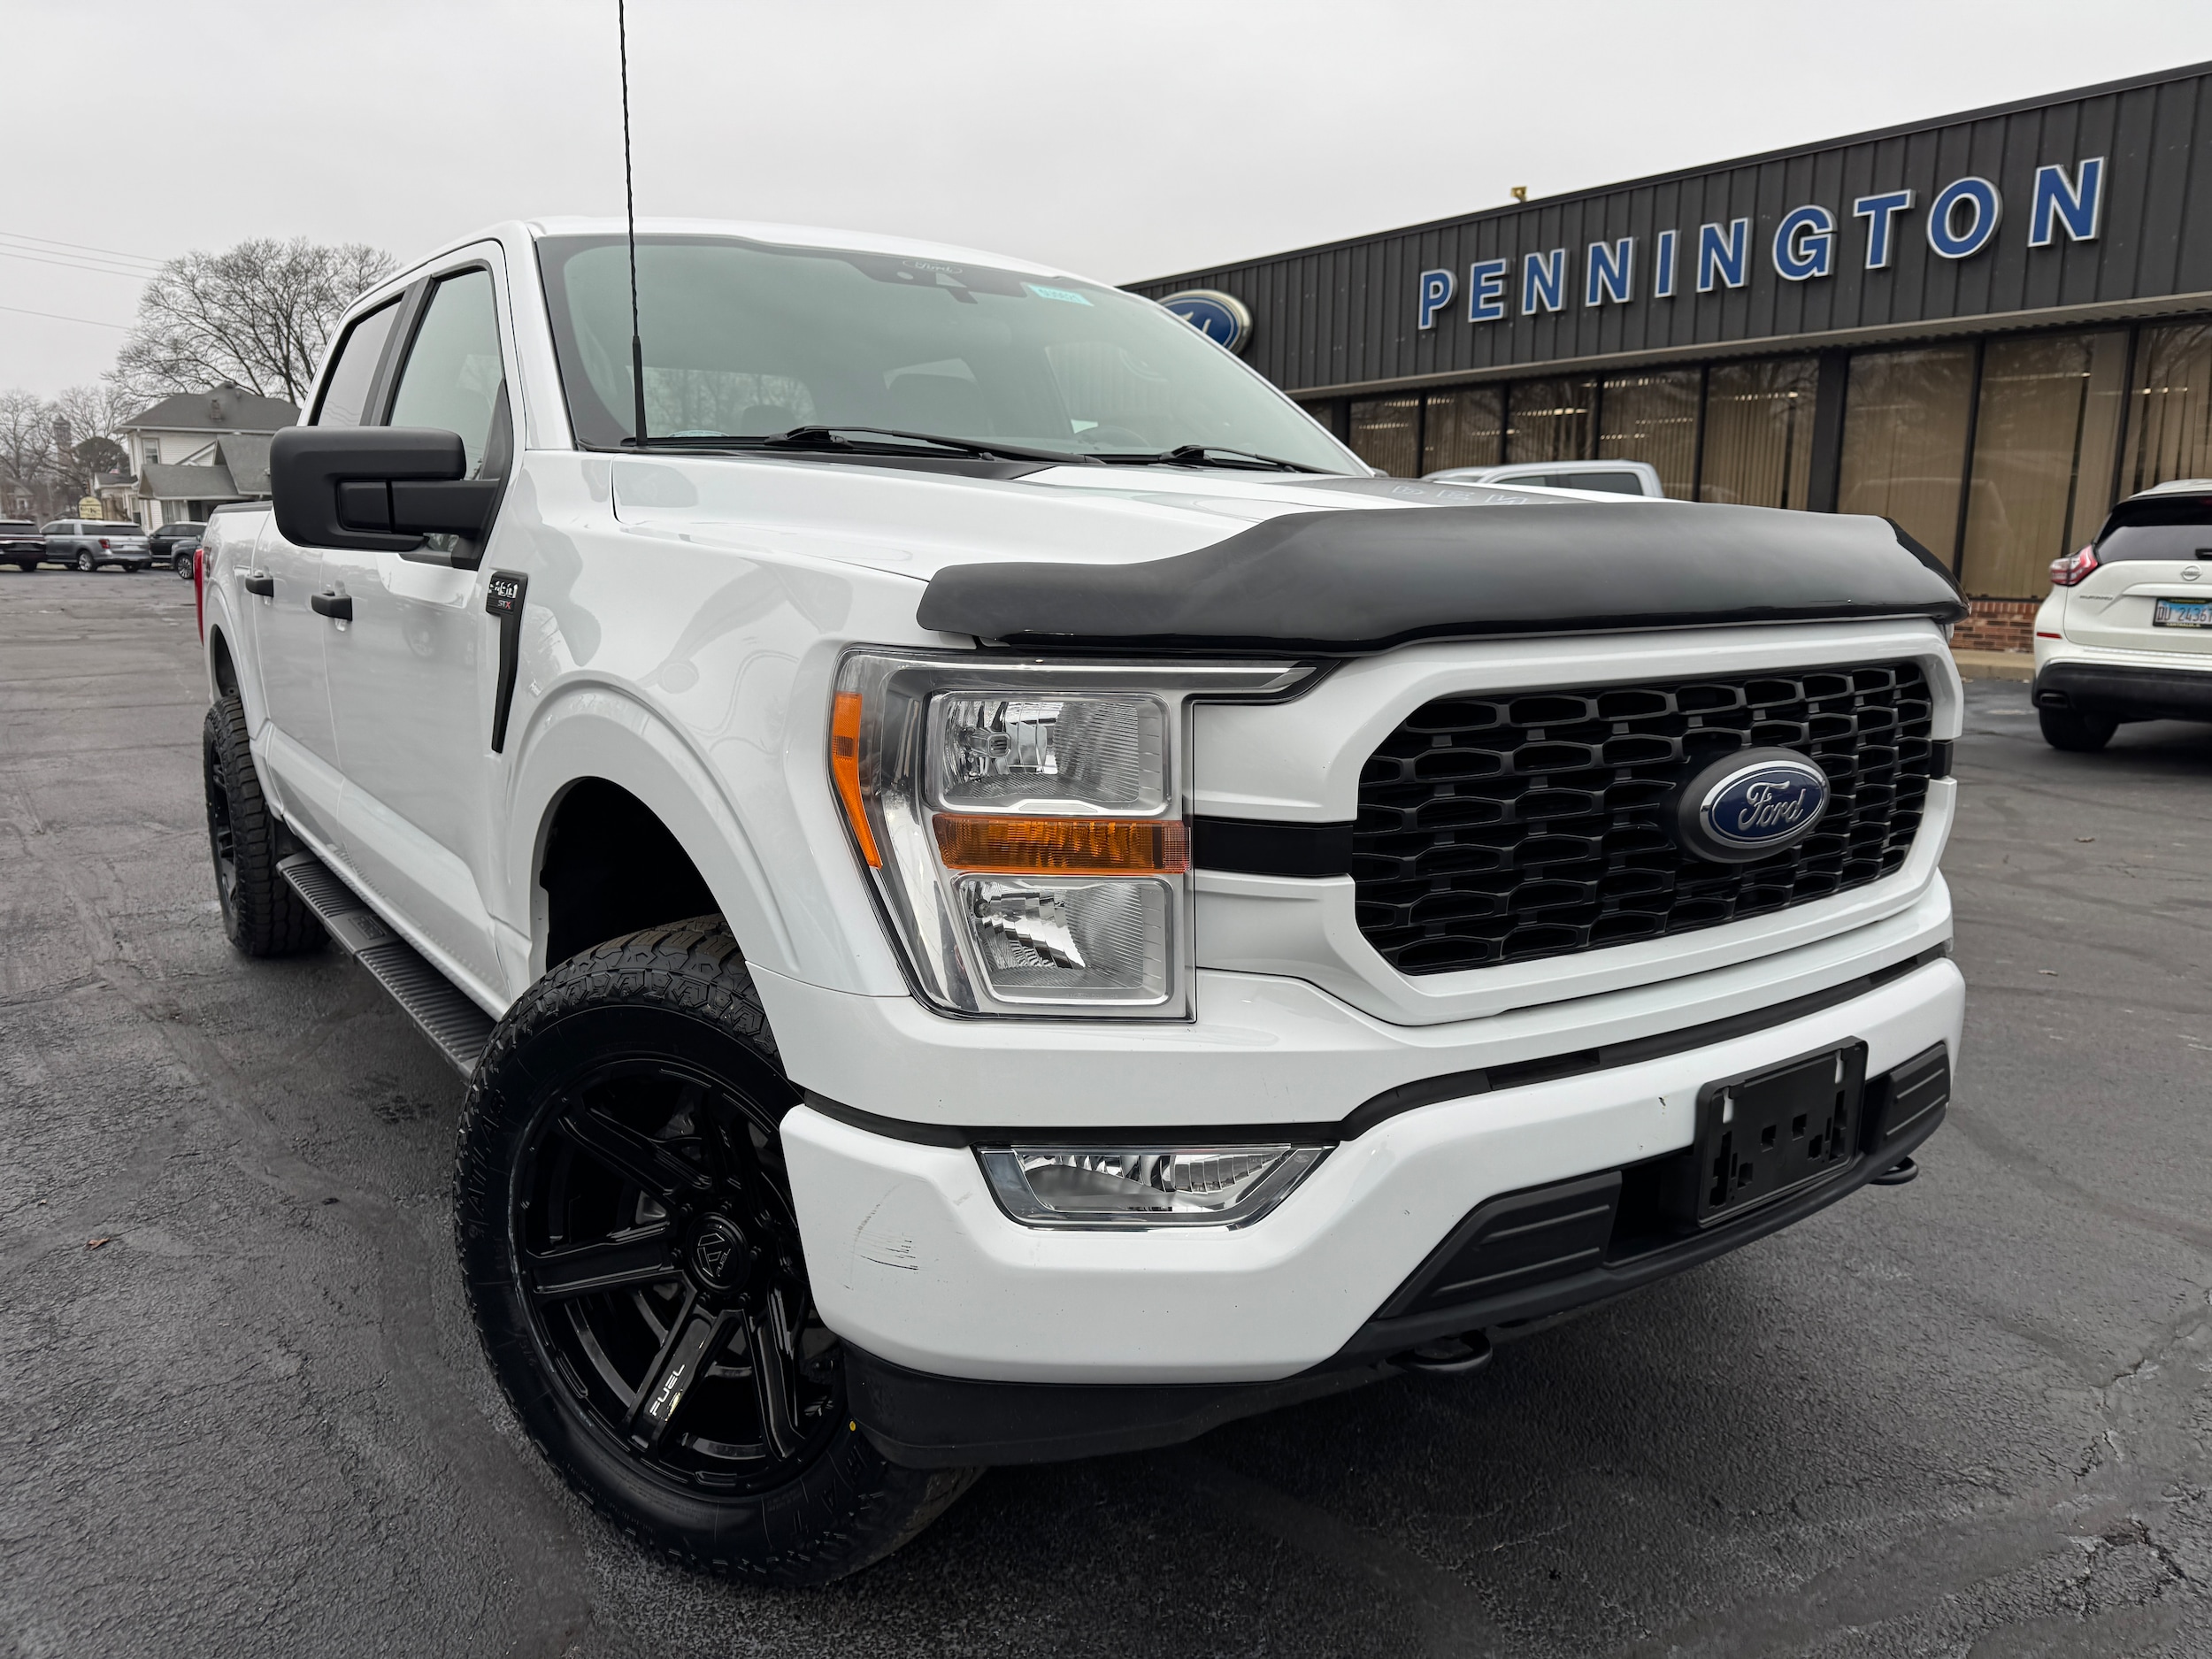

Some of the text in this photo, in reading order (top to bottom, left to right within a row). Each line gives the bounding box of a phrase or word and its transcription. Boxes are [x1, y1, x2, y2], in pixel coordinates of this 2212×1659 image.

[1417, 156, 2108, 330] PENNINGTON
[497, 600, 512, 611] STX
[2156, 606, 2173, 621] DU
[1737, 780, 1807, 831] Ford
[716, 1248, 732, 1278] FUEL
[649, 1363, 685, 1416] FUEL
